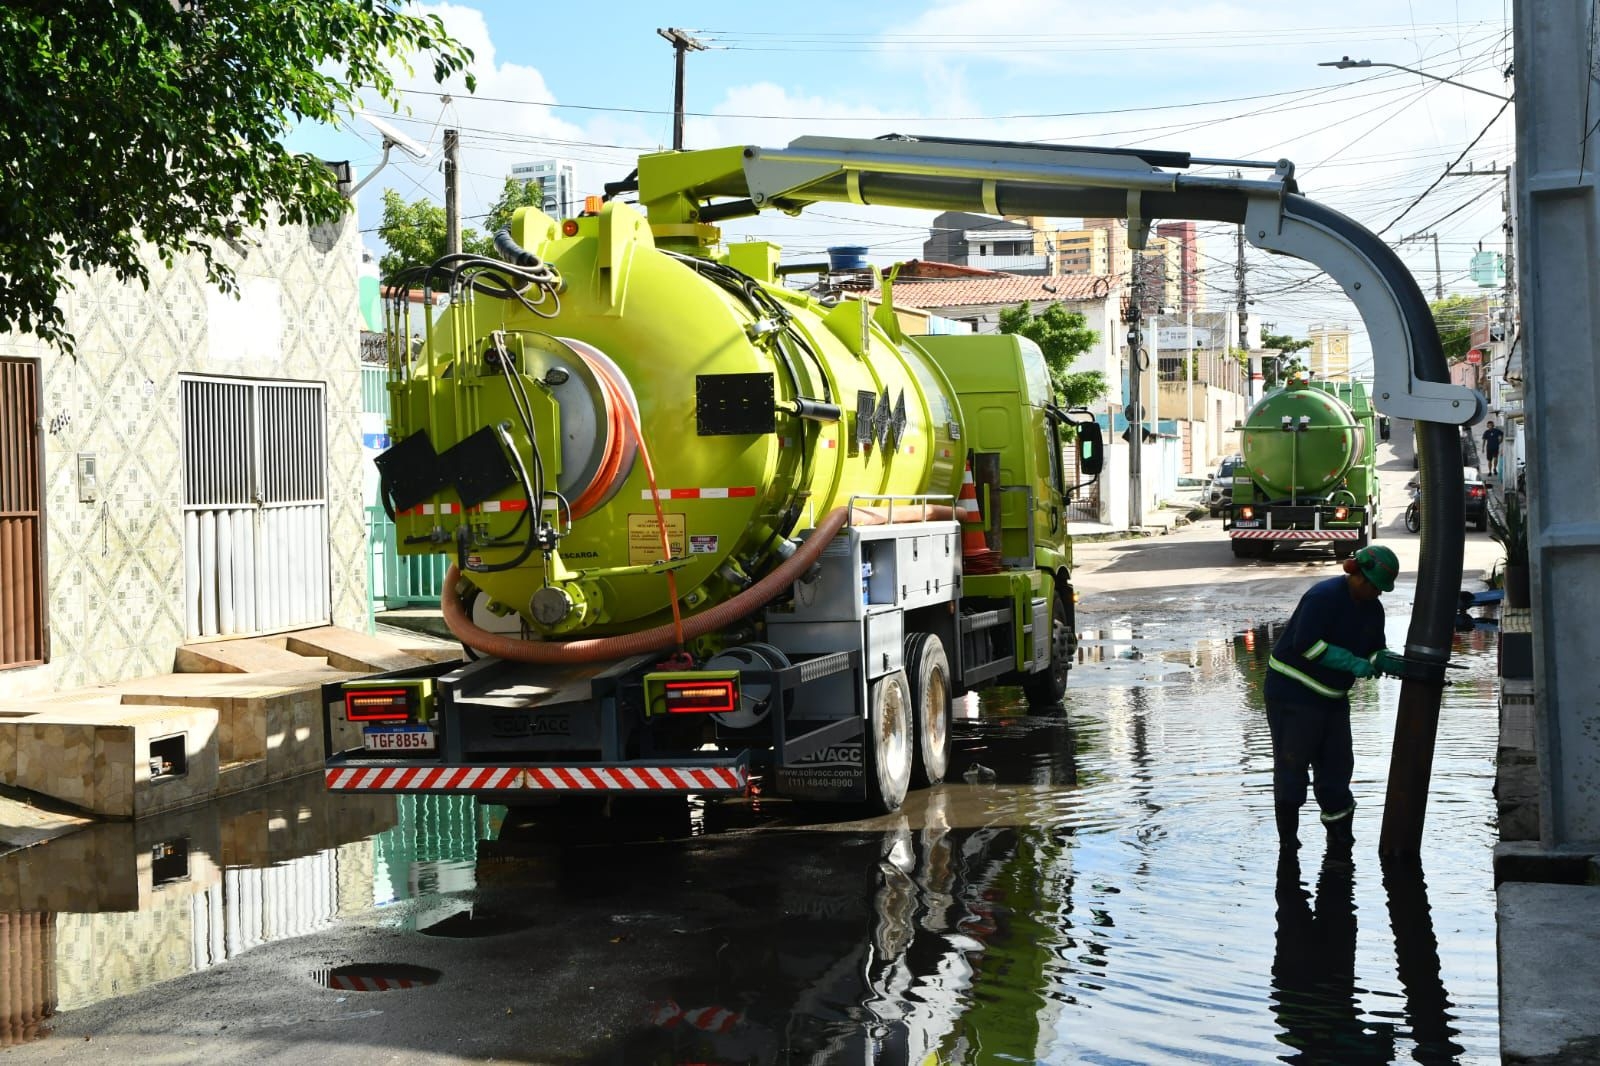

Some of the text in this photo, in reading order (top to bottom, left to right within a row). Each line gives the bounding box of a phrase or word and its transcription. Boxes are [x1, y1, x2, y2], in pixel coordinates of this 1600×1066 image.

[560, 551, 599, 559] ESCARGA
[371, 733, 428, 748] TGF8B54
[783, 768, 863, 777] ww.solivacc.com.br
